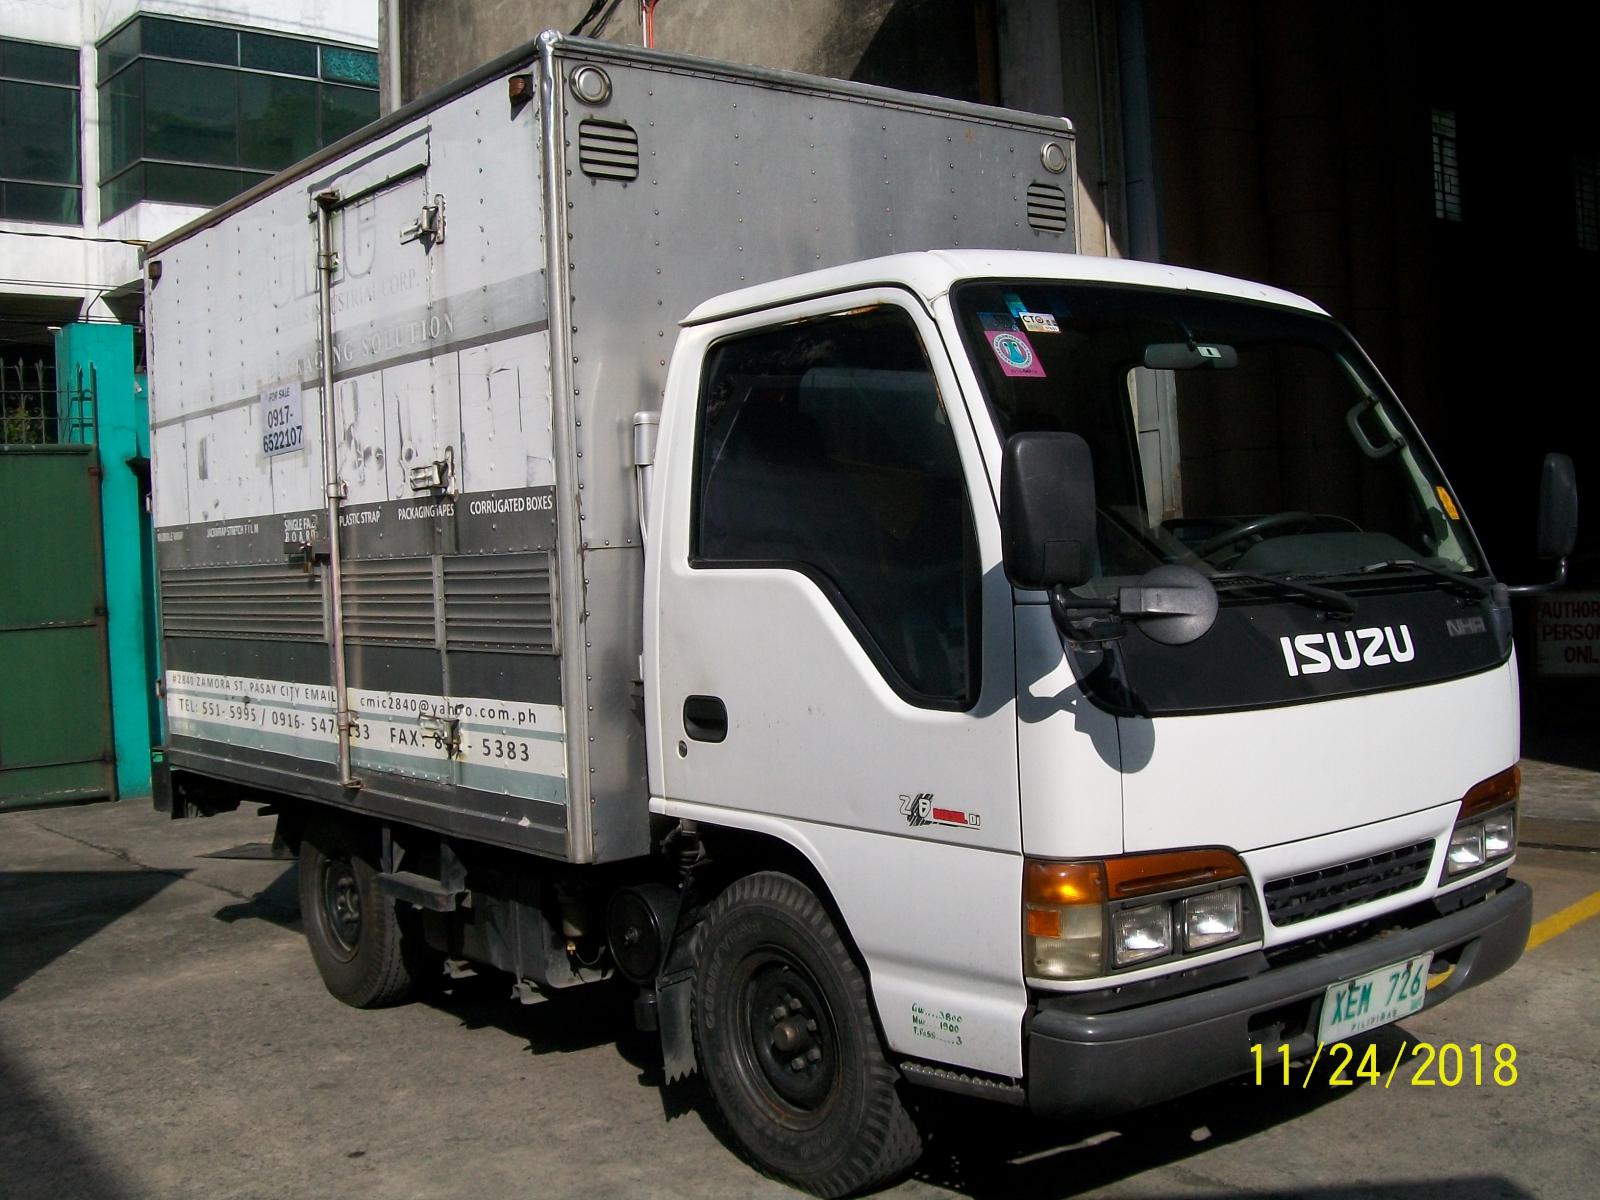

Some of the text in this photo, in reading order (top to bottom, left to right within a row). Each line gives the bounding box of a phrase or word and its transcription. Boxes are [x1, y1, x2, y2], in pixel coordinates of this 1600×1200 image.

[279, 387, 290, 399] SALE
[267, 405, 293, 428] 0917-
[263, 425, 303, 453] 6522107
[397, 506, 435, 521] PACKAGING
[469, 495, 553, 516] CORRUGATED BOXES
[339, 510, 381, 527] PLASTIC STRAP
[1280, 624, 1415, 677] ISUZU
[196, 676, 231, 691] ZAMORA
[250, 682, 276, 696] PASAY
[280, 686, 300, 699] CITY
[482, 738, 530, 762] 5383
[1330, 965, 1424, 1025] XEM 726
